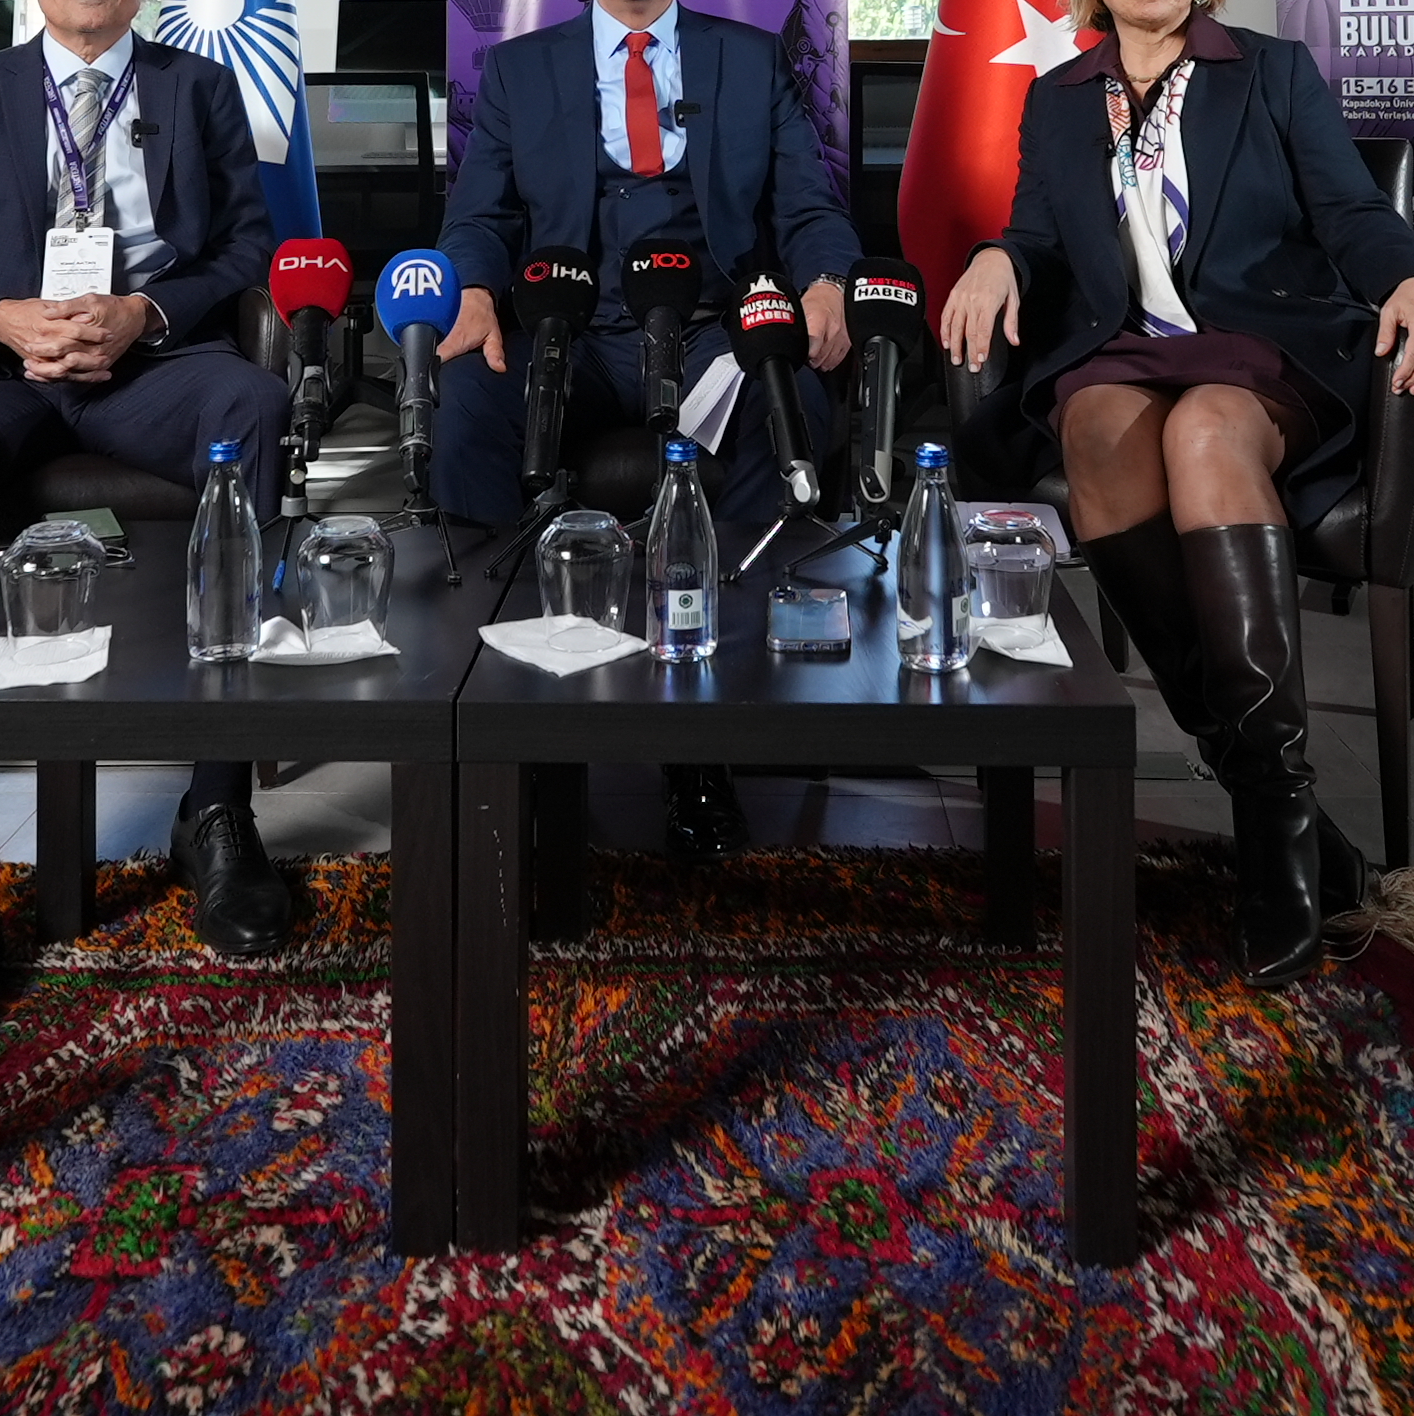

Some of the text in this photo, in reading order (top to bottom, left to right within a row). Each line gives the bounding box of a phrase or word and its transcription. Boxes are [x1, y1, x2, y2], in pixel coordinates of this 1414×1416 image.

[1342, 78, 1398, 94] 15-16
[1342, 99, 1391, 110] Kapadokya
[1342, 110, 1376, 120] Fabrika
[392, 267, 442, 300] AA
[858, 287, 914, 303] HABER
[746, 311, 791, 326] HABER
